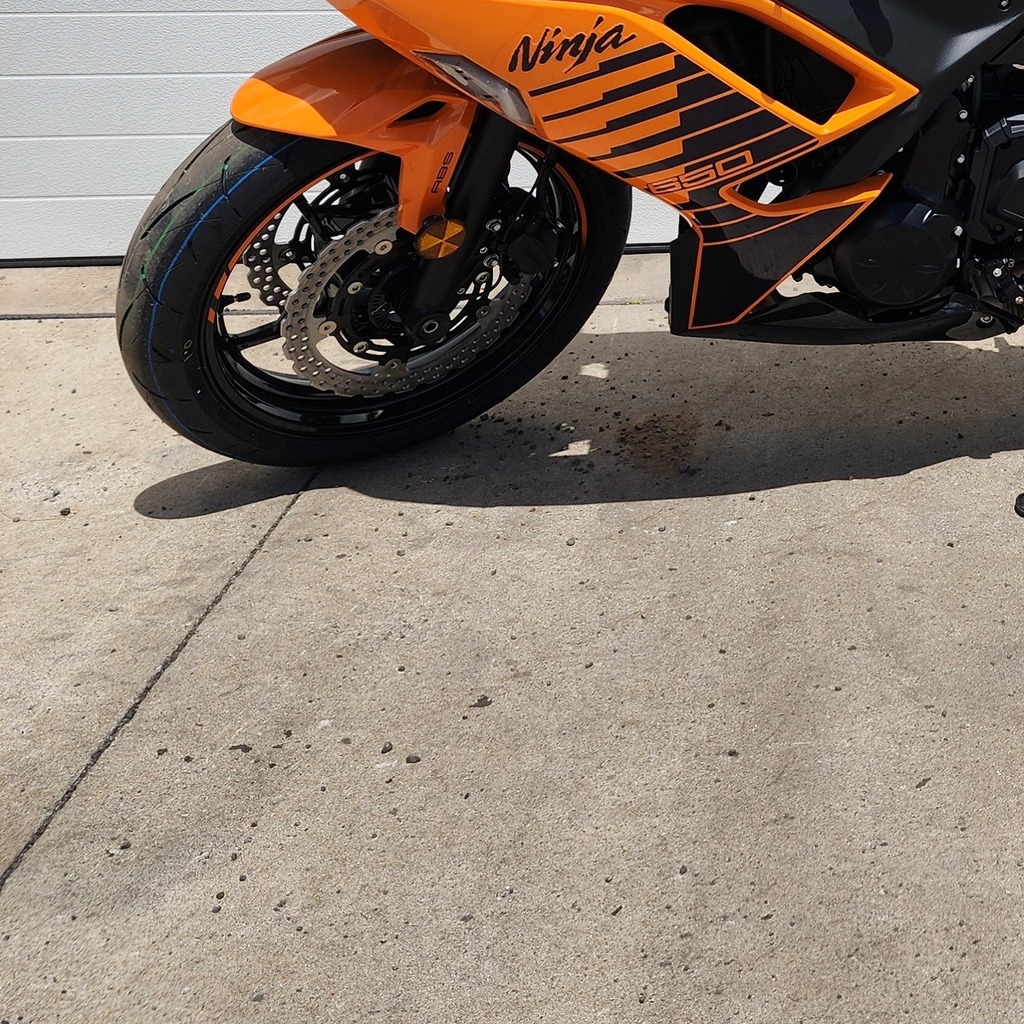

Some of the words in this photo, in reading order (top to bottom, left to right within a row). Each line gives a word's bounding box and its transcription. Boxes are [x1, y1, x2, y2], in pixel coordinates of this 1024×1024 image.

[508, 16, 637, 74] Ninja
[431, 151, 454, 193] ABS
[647, 149, 754, 195] 650
